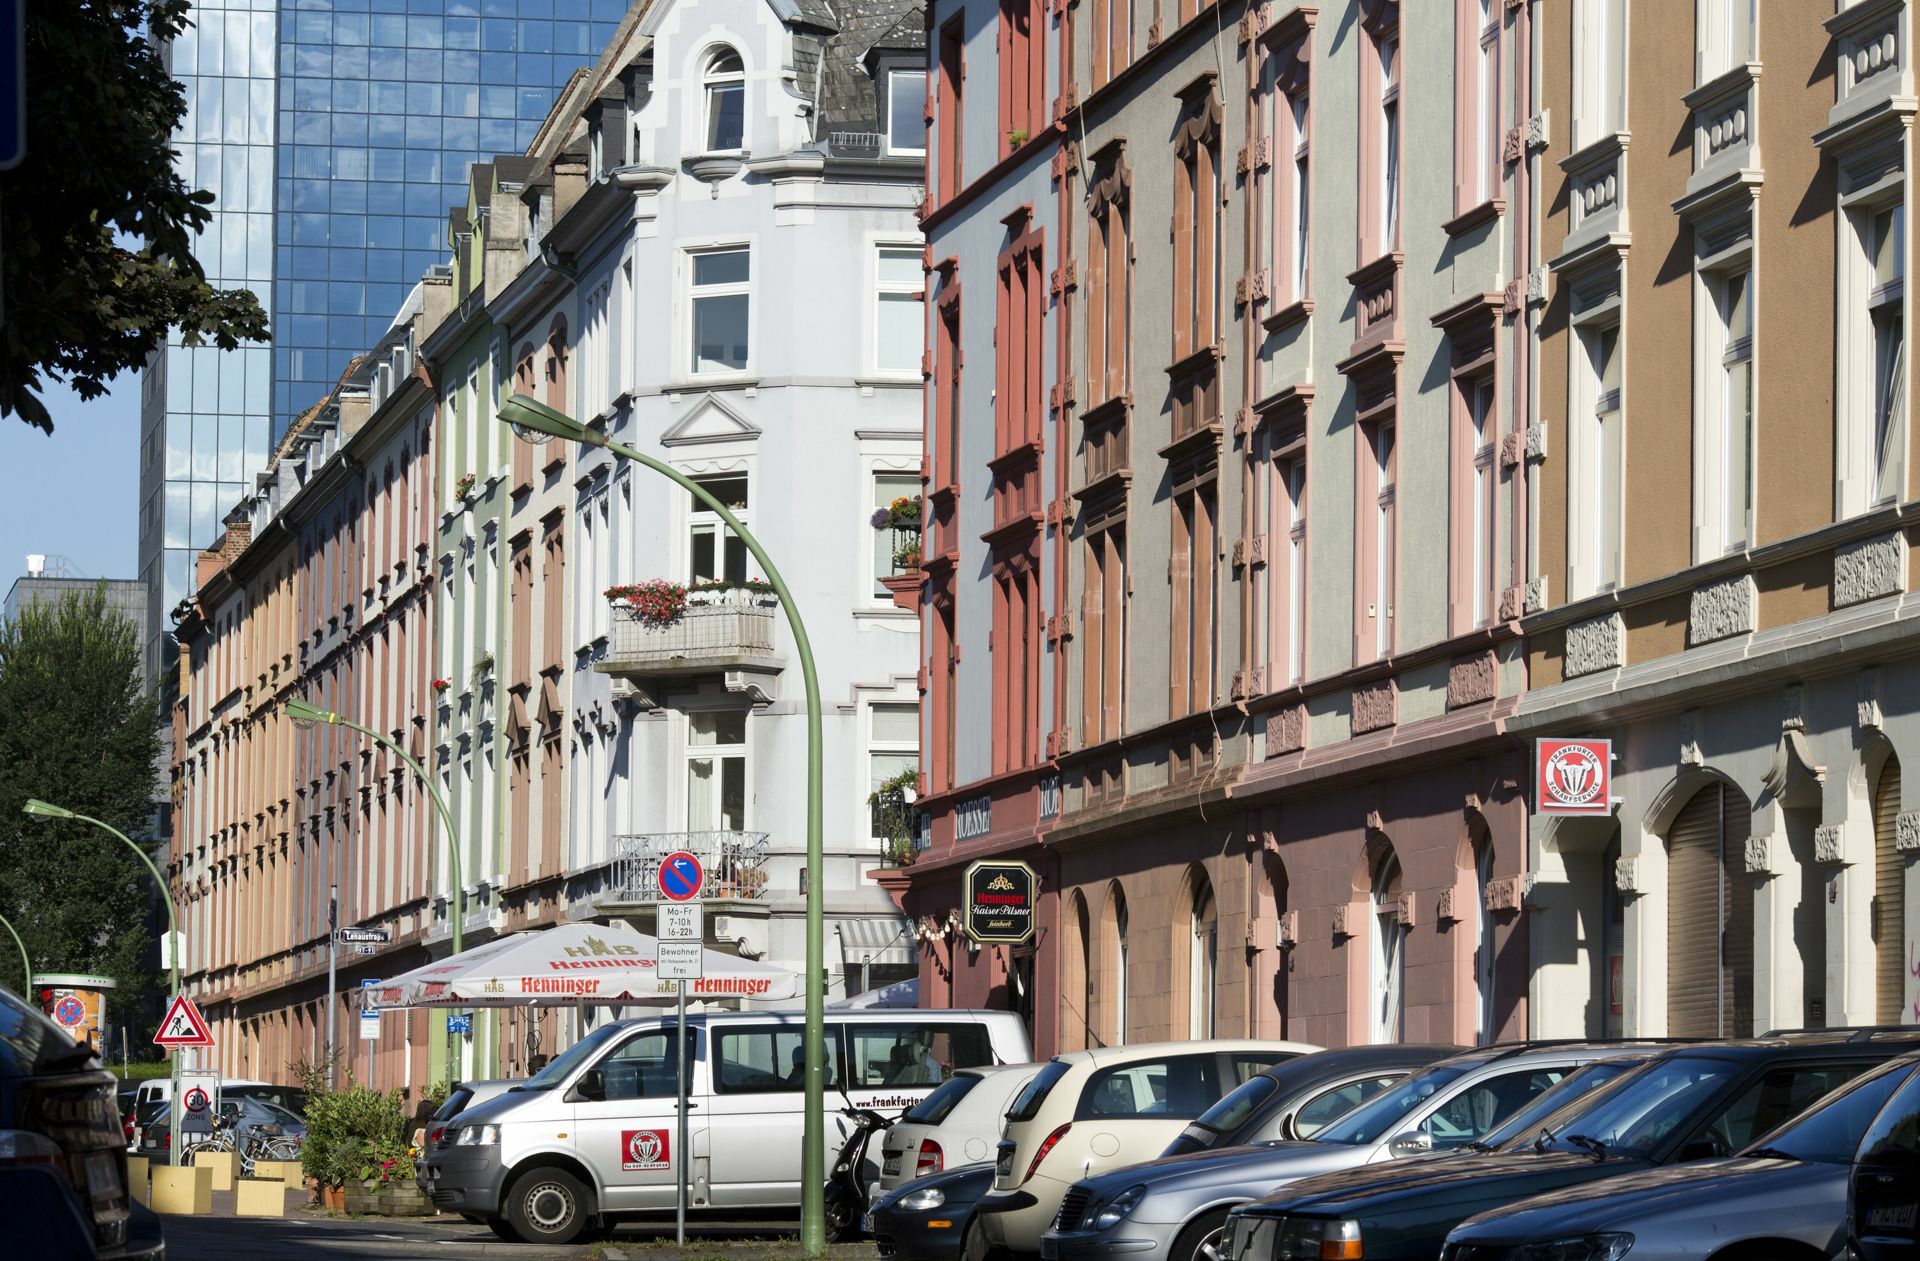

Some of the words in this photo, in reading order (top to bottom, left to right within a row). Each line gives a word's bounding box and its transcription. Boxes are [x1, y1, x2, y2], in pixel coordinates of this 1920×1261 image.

[1550, 746, 1598, 763] FRANKFURTER
[1549, 781, 1600, 803] SCHARFSERVICE
[977, 893, 1025, 906] Henninger
[971, 904, 1000, 915] Kaiser
[1000, 904, 1031, 916] Pilsner
[668, 928, 693, 936] 16-22h
[661, 947, 698, 956] Bewohner
[521, 977, 600, 995] Henninger
[694, 976, 771, 995] Henninger
[189, 1094, 204, 1106] 30
